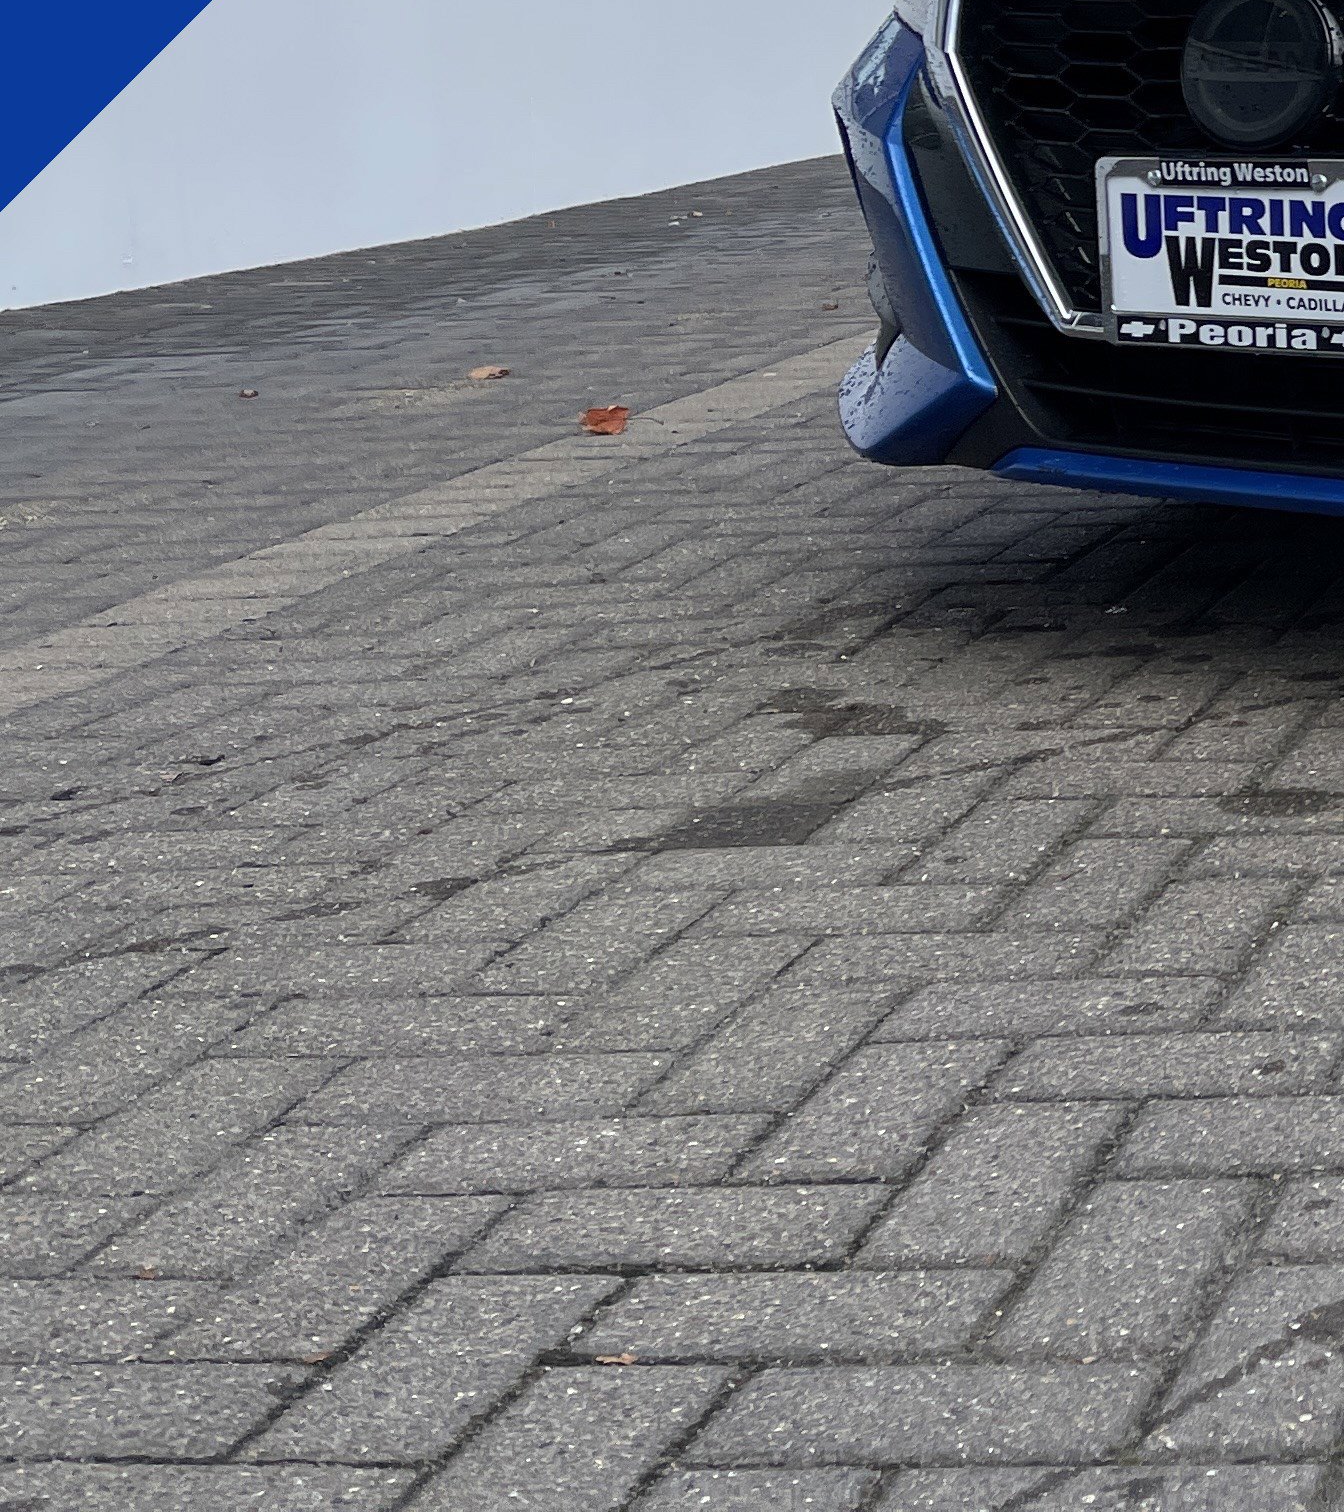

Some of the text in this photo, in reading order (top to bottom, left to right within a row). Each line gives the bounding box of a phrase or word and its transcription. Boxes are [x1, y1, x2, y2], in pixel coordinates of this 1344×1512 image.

[1161, 162, 1309, 186] Uftring Weston
[1267, 277, 1307, 289] PEORIA
[1221, 293, 1271, 308] CHEVY
[1167, 318, 1318, 350] Peoria
